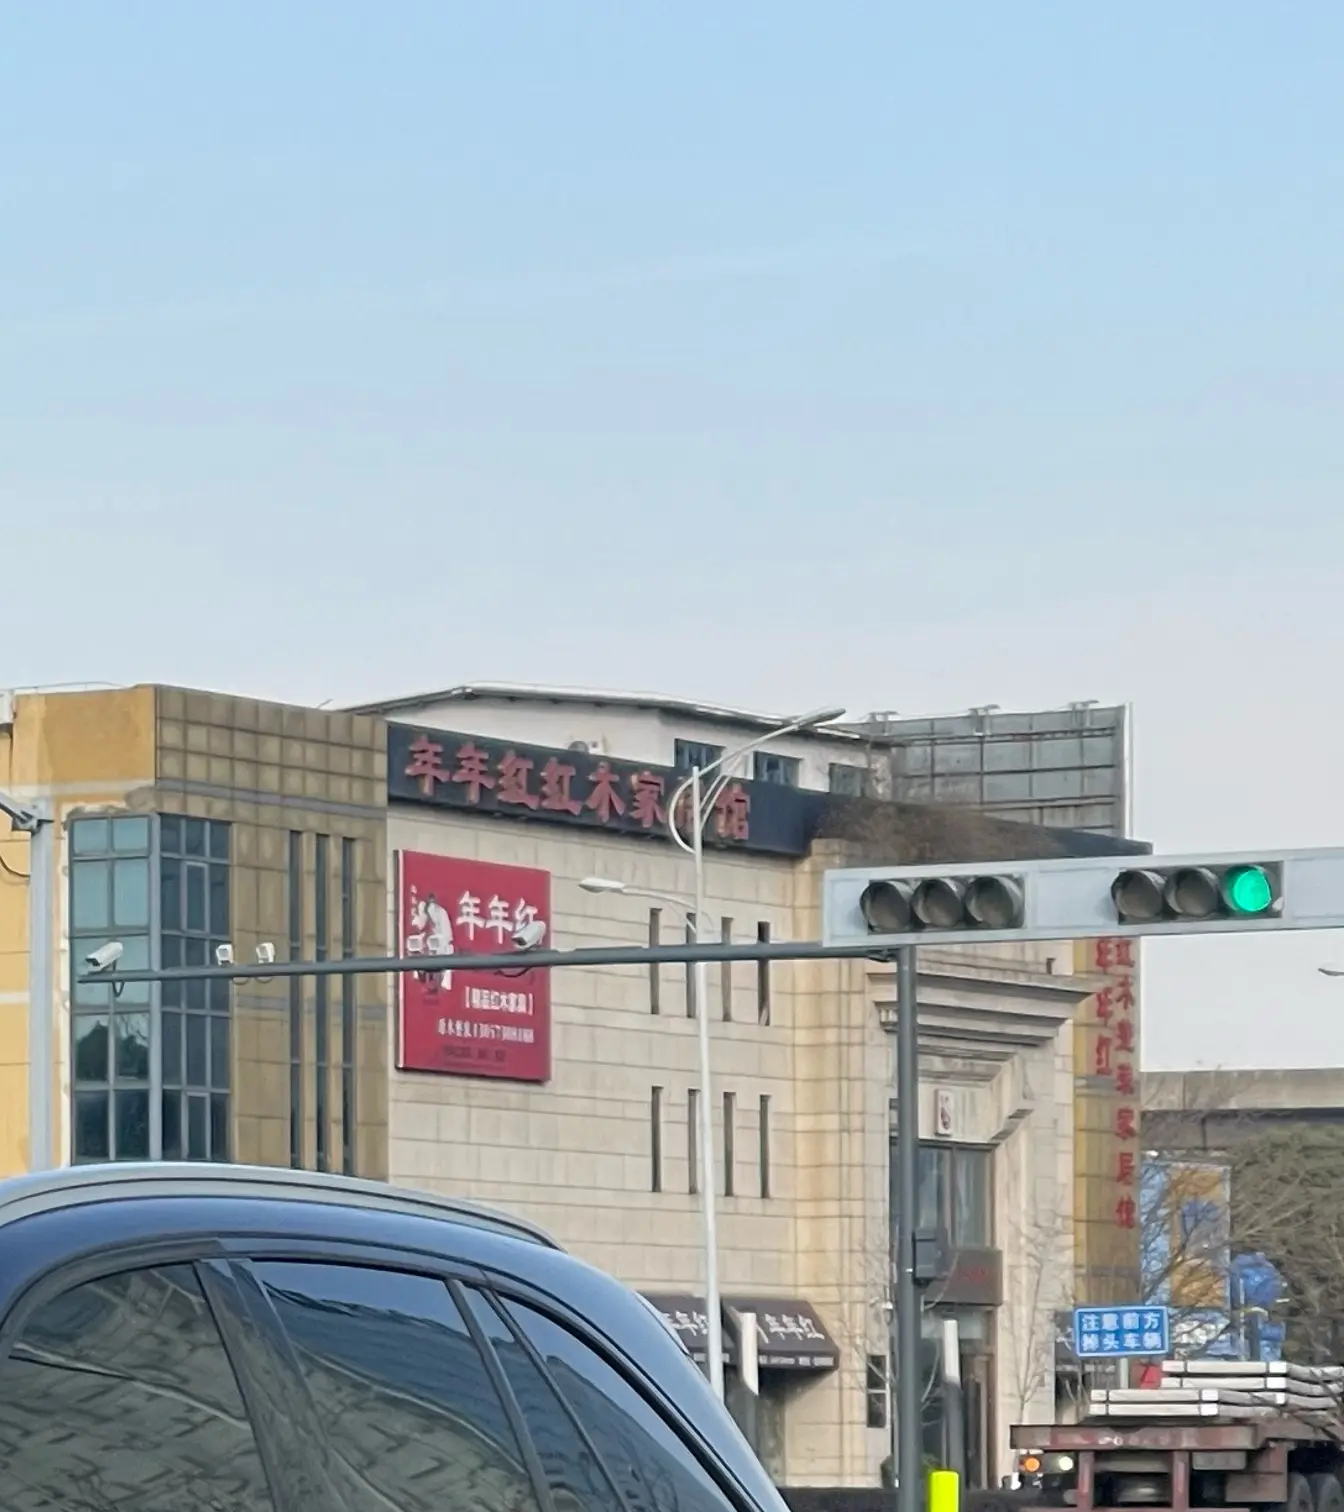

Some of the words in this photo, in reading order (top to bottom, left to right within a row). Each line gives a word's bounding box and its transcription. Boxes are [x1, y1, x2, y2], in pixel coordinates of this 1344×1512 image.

[404, 733, 749, 840] 年年红红木家馆
[1082, 1312, 1161, 1332] 注意前方
